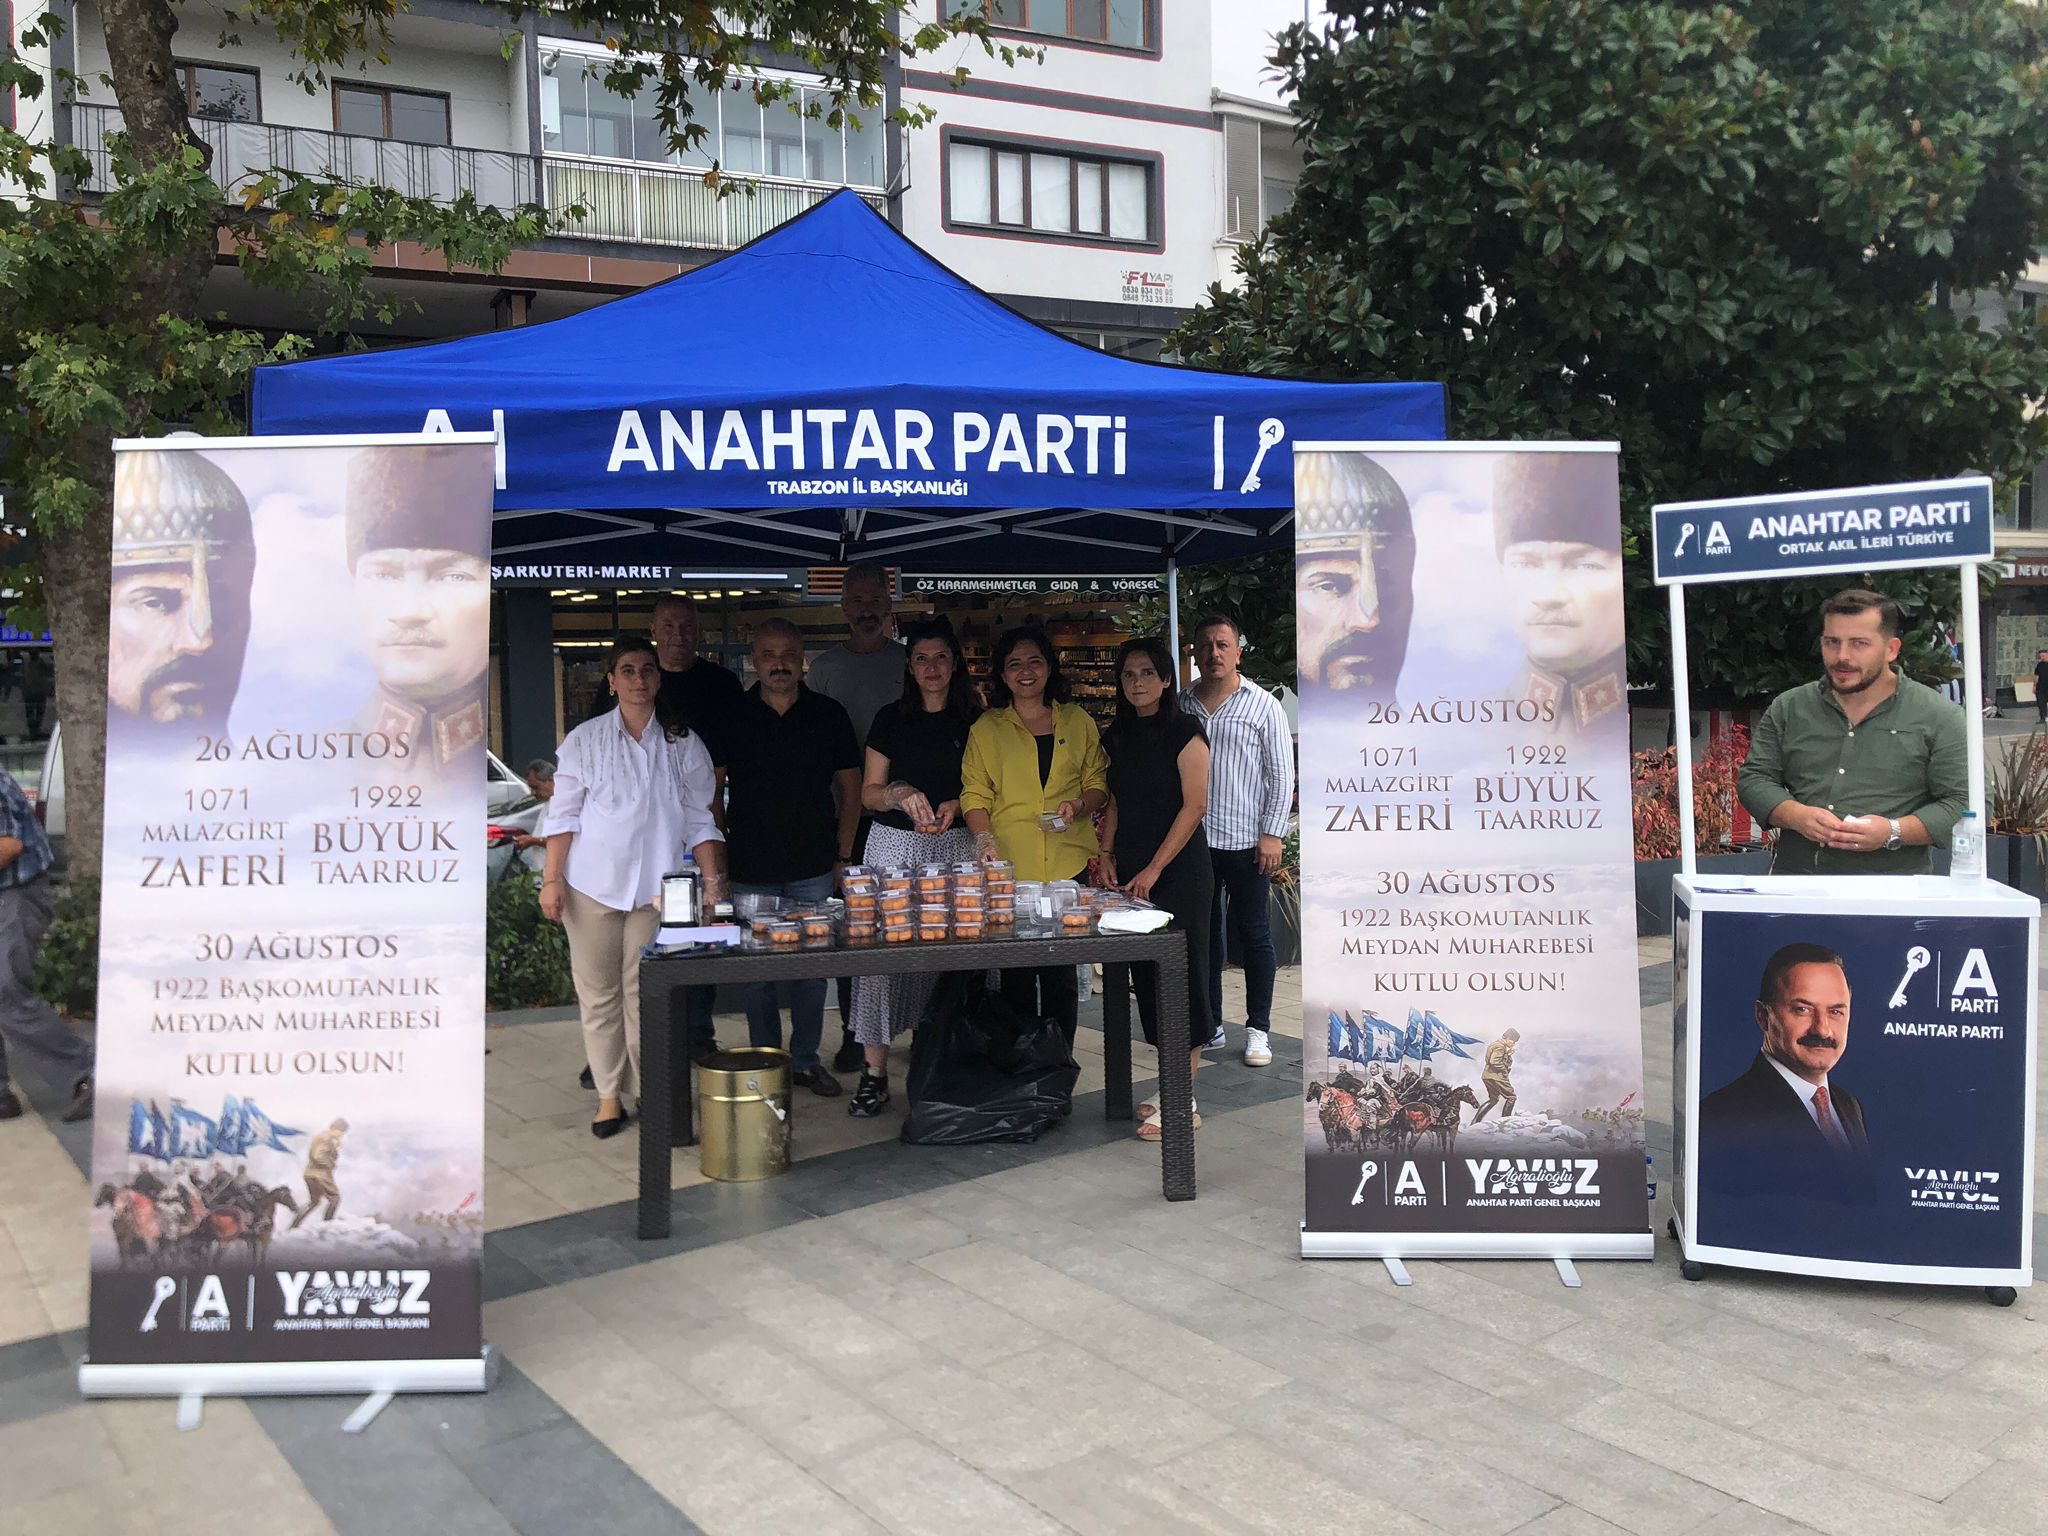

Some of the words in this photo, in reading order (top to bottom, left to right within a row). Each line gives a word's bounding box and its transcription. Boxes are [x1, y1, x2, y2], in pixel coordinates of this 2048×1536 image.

[607, 409, 936, 472] ANAHTAR
[767, 480, 849, 495] TRABZON
[852, 477, 867, 494] İL
[870, 479, 968, 497] BAŞKANLIĞI
[1706, 520, 1731, 547] A
[1748, 508, 1882, 539] ANAHTAR
[1779, 541, 1824, 555] ORTAK
[1828, 539, 1857, 551] AKIL
[1897, 530, 1954, 546] TÜRKİYE
[916, 577, 934, 590] ÖZ
[937, 580, 1037, 591] KARAMEHMETLER
[1050, 580, 1079, 590] GIDA
[1090, 580, 1099, 590] &
[1113, 578, 1160, 590] YÖRESEL
[1368, 701, 1400, 725] 26
[1408, 696, 1556, 724] AĞUSTOS
[196, 735, 231, 762] 26
[240, 729, 411, 761] AĞUSTOS
[1359, 746, 1418, 767] 1071
[1506, 744, 1567, 765] 1922
[1325, 772, 1453, 793] MALAZGİRT
[1474, 772, 1601, 803] BÜYÜK
[184, 787, 249, 812] 1071
[349, 785, 422, 808] 1922
[1325, 797, 1454, 832] ZAFERİ
[1474, 808, 1603, 830] TAARRUZ
[141, 818, 289, 843] MALAZGİRT
[312, 816, 459, 853] BÜYÜK
[140, 848, 286, 888] ZAFERİ
[310, 858, 460, 885] TAARRUZ
[1376, 871, 1410, 895] 30
[1418, 869, 1556, 894] AĞUSTOS
[1339, 908, 1391, 928] 1922
[1399, 908, 1593, 931] BAŞKOMUTANLIK
[195, 933, 233, 962] 30
[245, 931, 399, 961] AĞUSTOS
[1341, 937, 1440, 956] MEYDAN
[1449, 934, 1595, 955] MUHAREBESİ
[1373, 972, 1460, 992] KUTLU
[1467, 971, 1566, 991] OLSUN!
[1951, 948, 1999, 997] A
[152, 977, 209, 1001] 1922
[219, 976, 441, 1003] BAŞKOMUTANLIK
[150, 1011, 264, 1033] MEYDAN
[274, 1005, 442, 1031] MUHAREBESİ
[1883, 1022, 1957, 1038] ANAHTAR
[185, 1052, 284, 1076] KUTLU
[293, 1050, 404, 1074] OLSUN!
[1394, 1160, 1426, 1195] A
[1465, 1159, 1600, 1195] YAVUZ
[1904, 1167, 2000, 1203] YAVUZ
[1466, 1198, 1508, 1207] ANAHTAR
[1534, 1199, 1562, 1207] GENEL
[1563, 1199, 1601, 1208] BAŞKANI
[1911, 1200, 1939, 1208] ANAHTAR
[1975, 1204, 2000, 1212] BAŞKANI
[192, 1274, 231, 1317] A
[275, 1270, 431, 1315] YAVUZ
